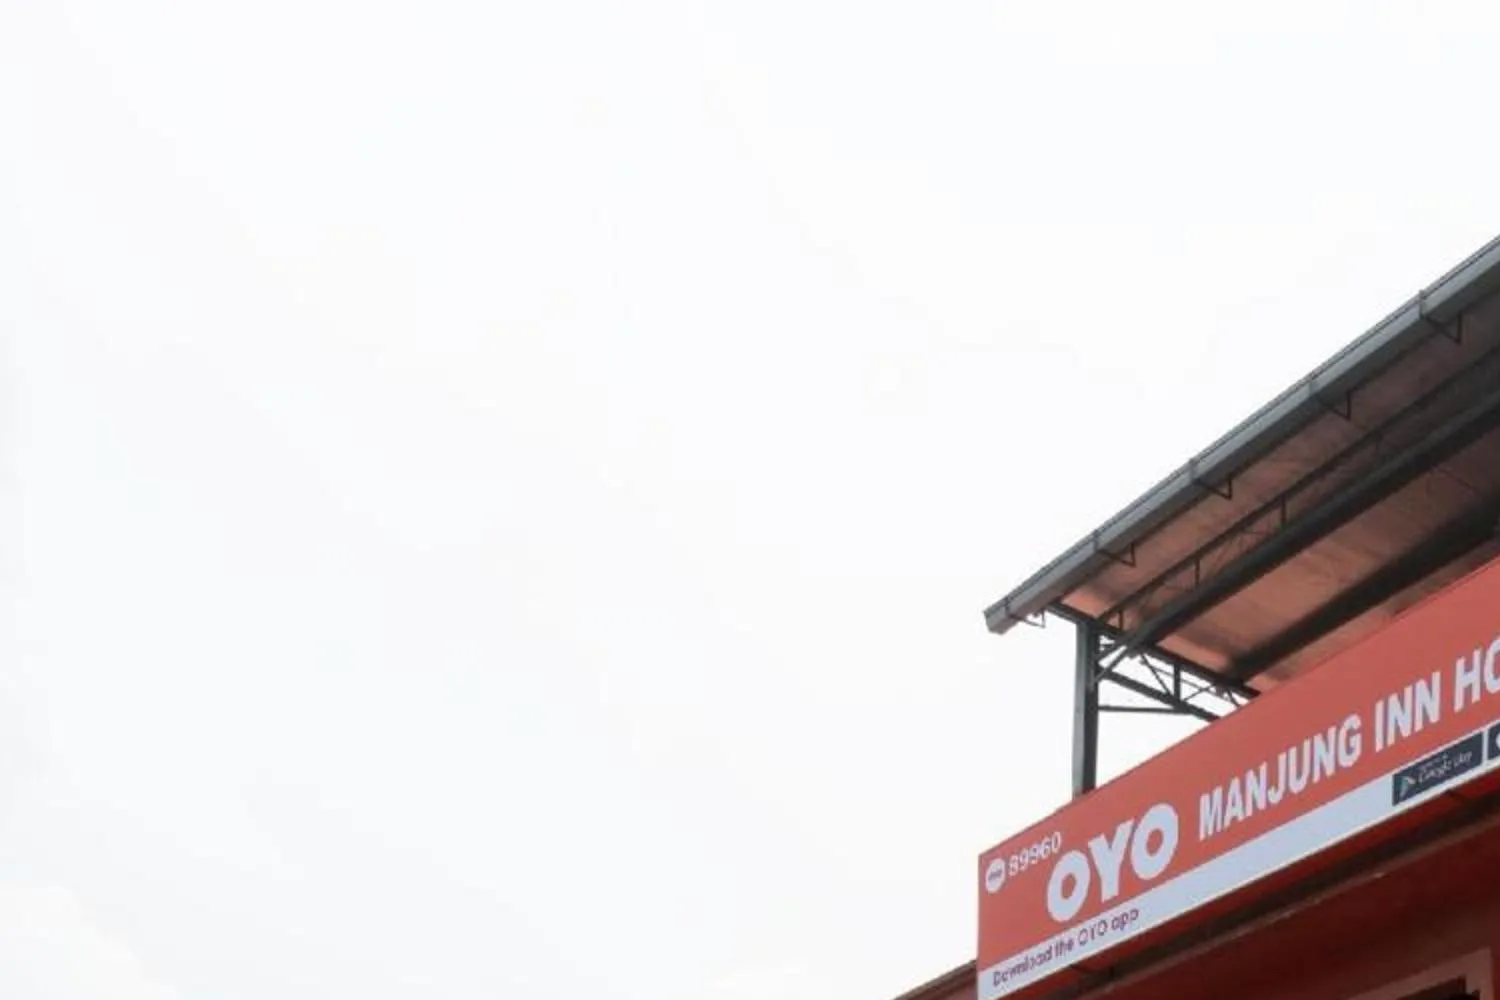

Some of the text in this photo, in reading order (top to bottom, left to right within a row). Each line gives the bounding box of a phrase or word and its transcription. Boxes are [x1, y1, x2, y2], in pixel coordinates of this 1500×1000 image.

[1200, 715, 1362, 840] MANJUNG
[1374, 671, 1441, 752] INN
[1008, 831, 1061, 876] 89960
[1047, 803, 1179, 923] OYO
[992, 908, 1140, 987] Download the OYO app
